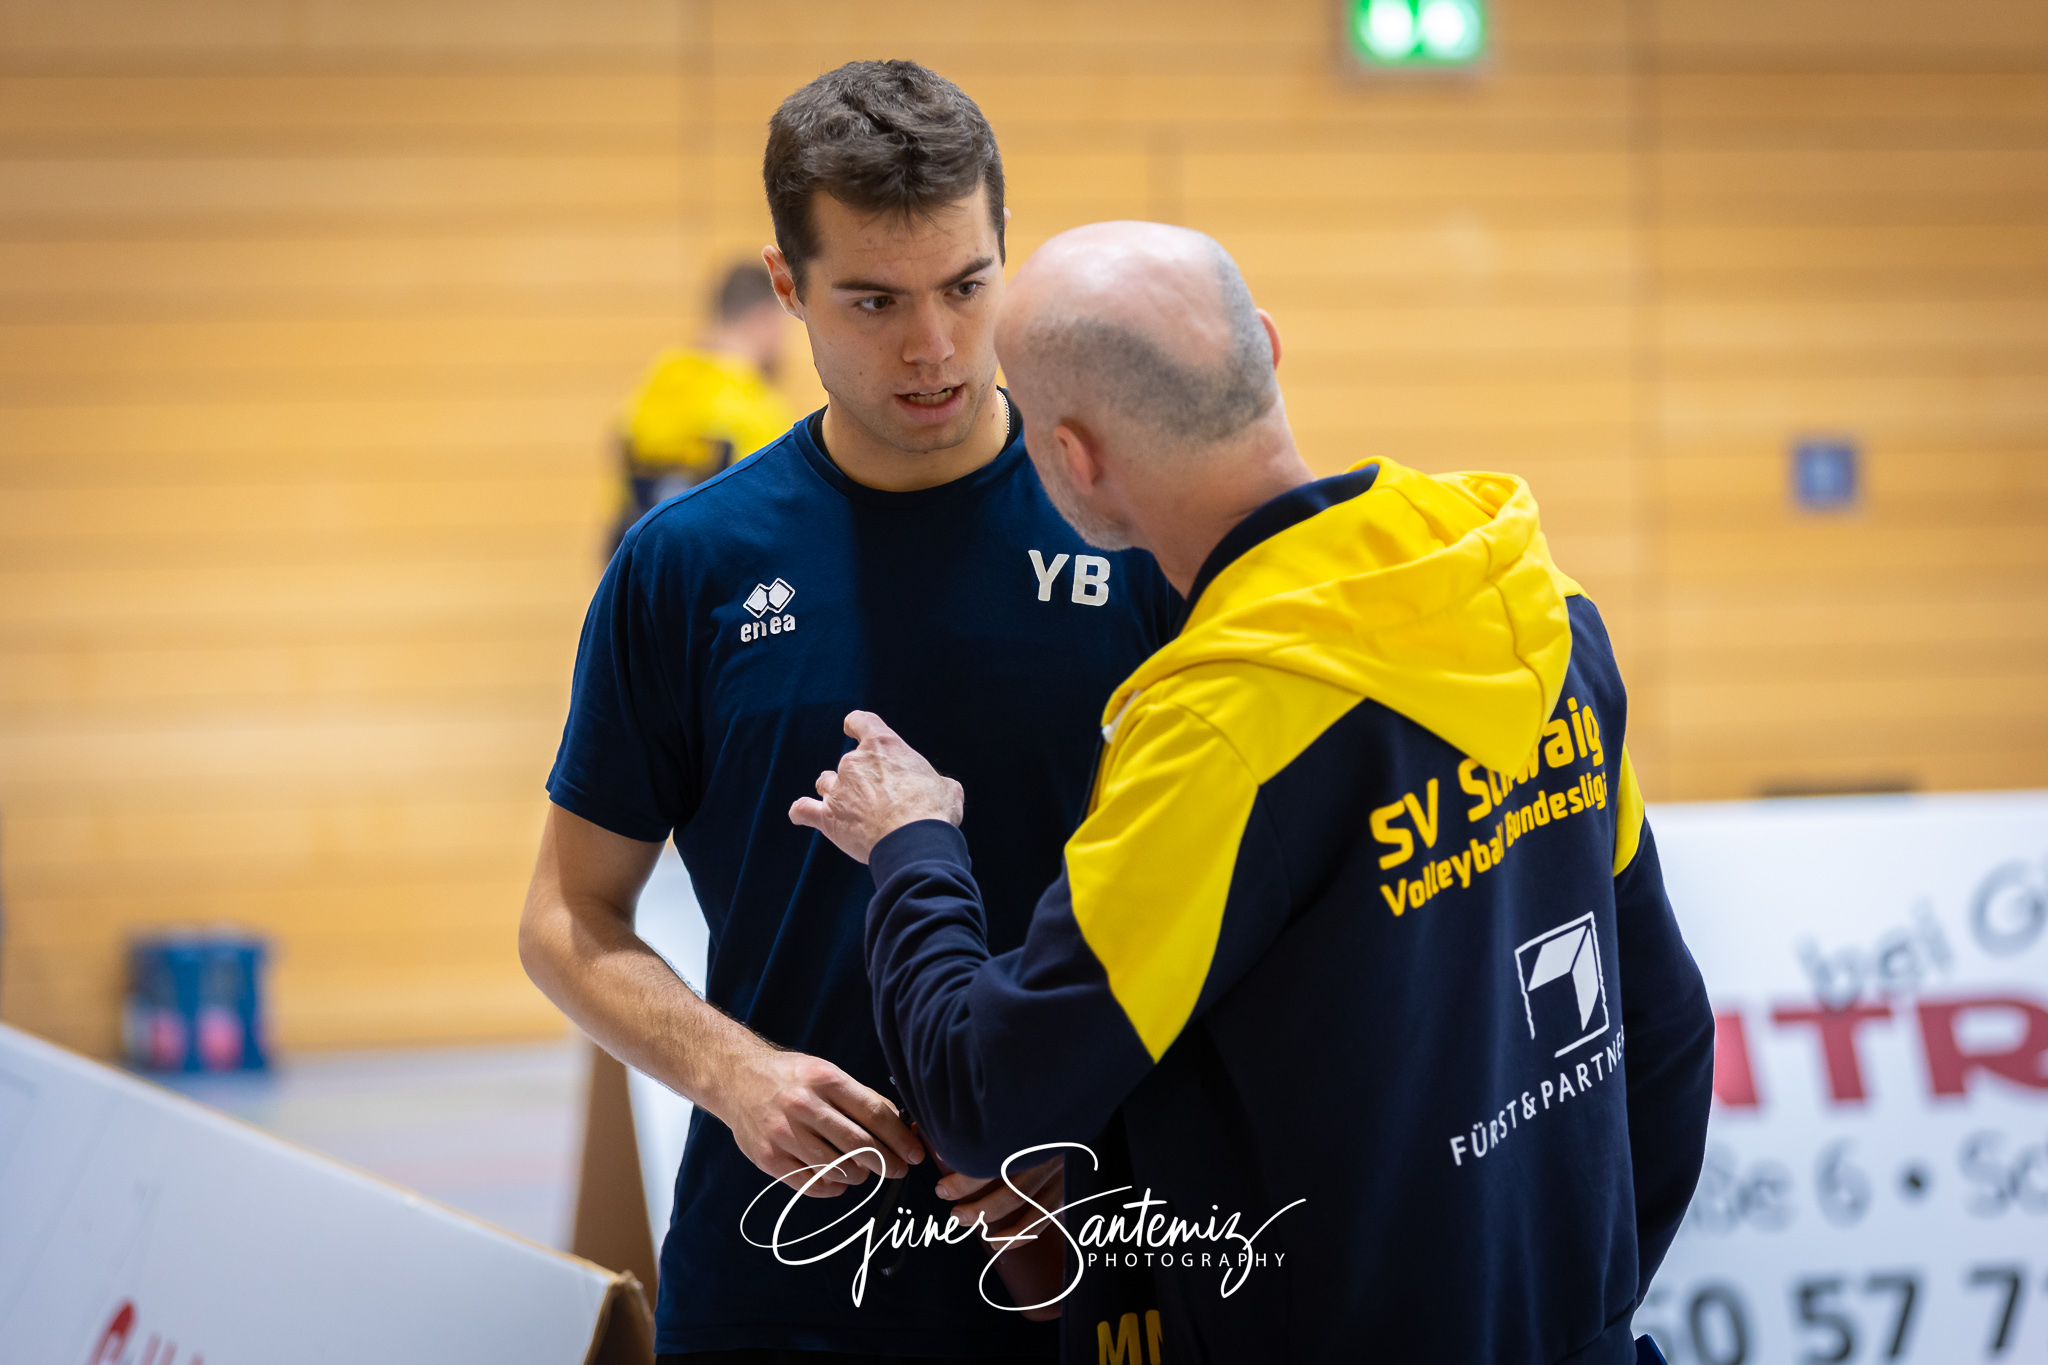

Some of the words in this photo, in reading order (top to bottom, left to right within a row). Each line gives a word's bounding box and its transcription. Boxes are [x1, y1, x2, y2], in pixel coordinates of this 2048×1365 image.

[1028, 549, 1110, 606] YB
[1369, 777, 1439, 870] SV
[1797, 1270, 1918, 1365] 57
